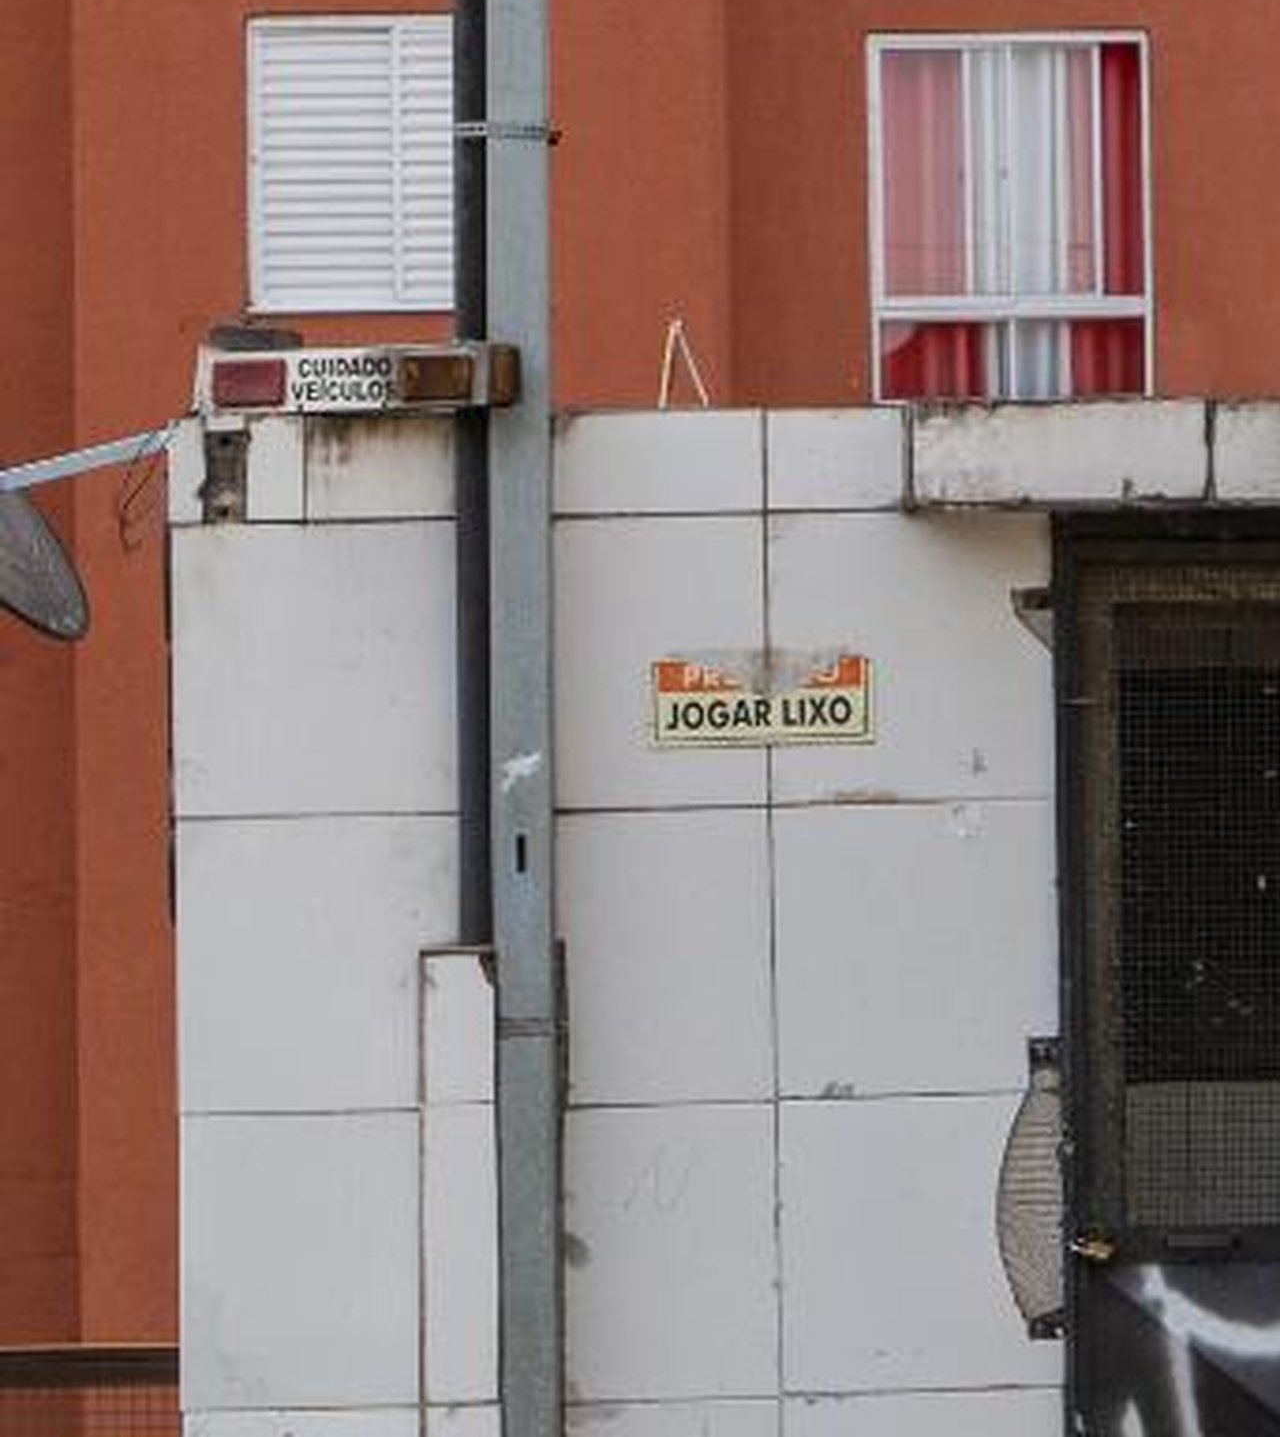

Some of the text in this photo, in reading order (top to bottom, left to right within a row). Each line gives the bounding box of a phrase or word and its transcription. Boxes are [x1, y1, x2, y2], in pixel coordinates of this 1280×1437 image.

[298, 358, 393, 378] CUIDADO
[667, 696, 853, 731] JOGAR LIXO
